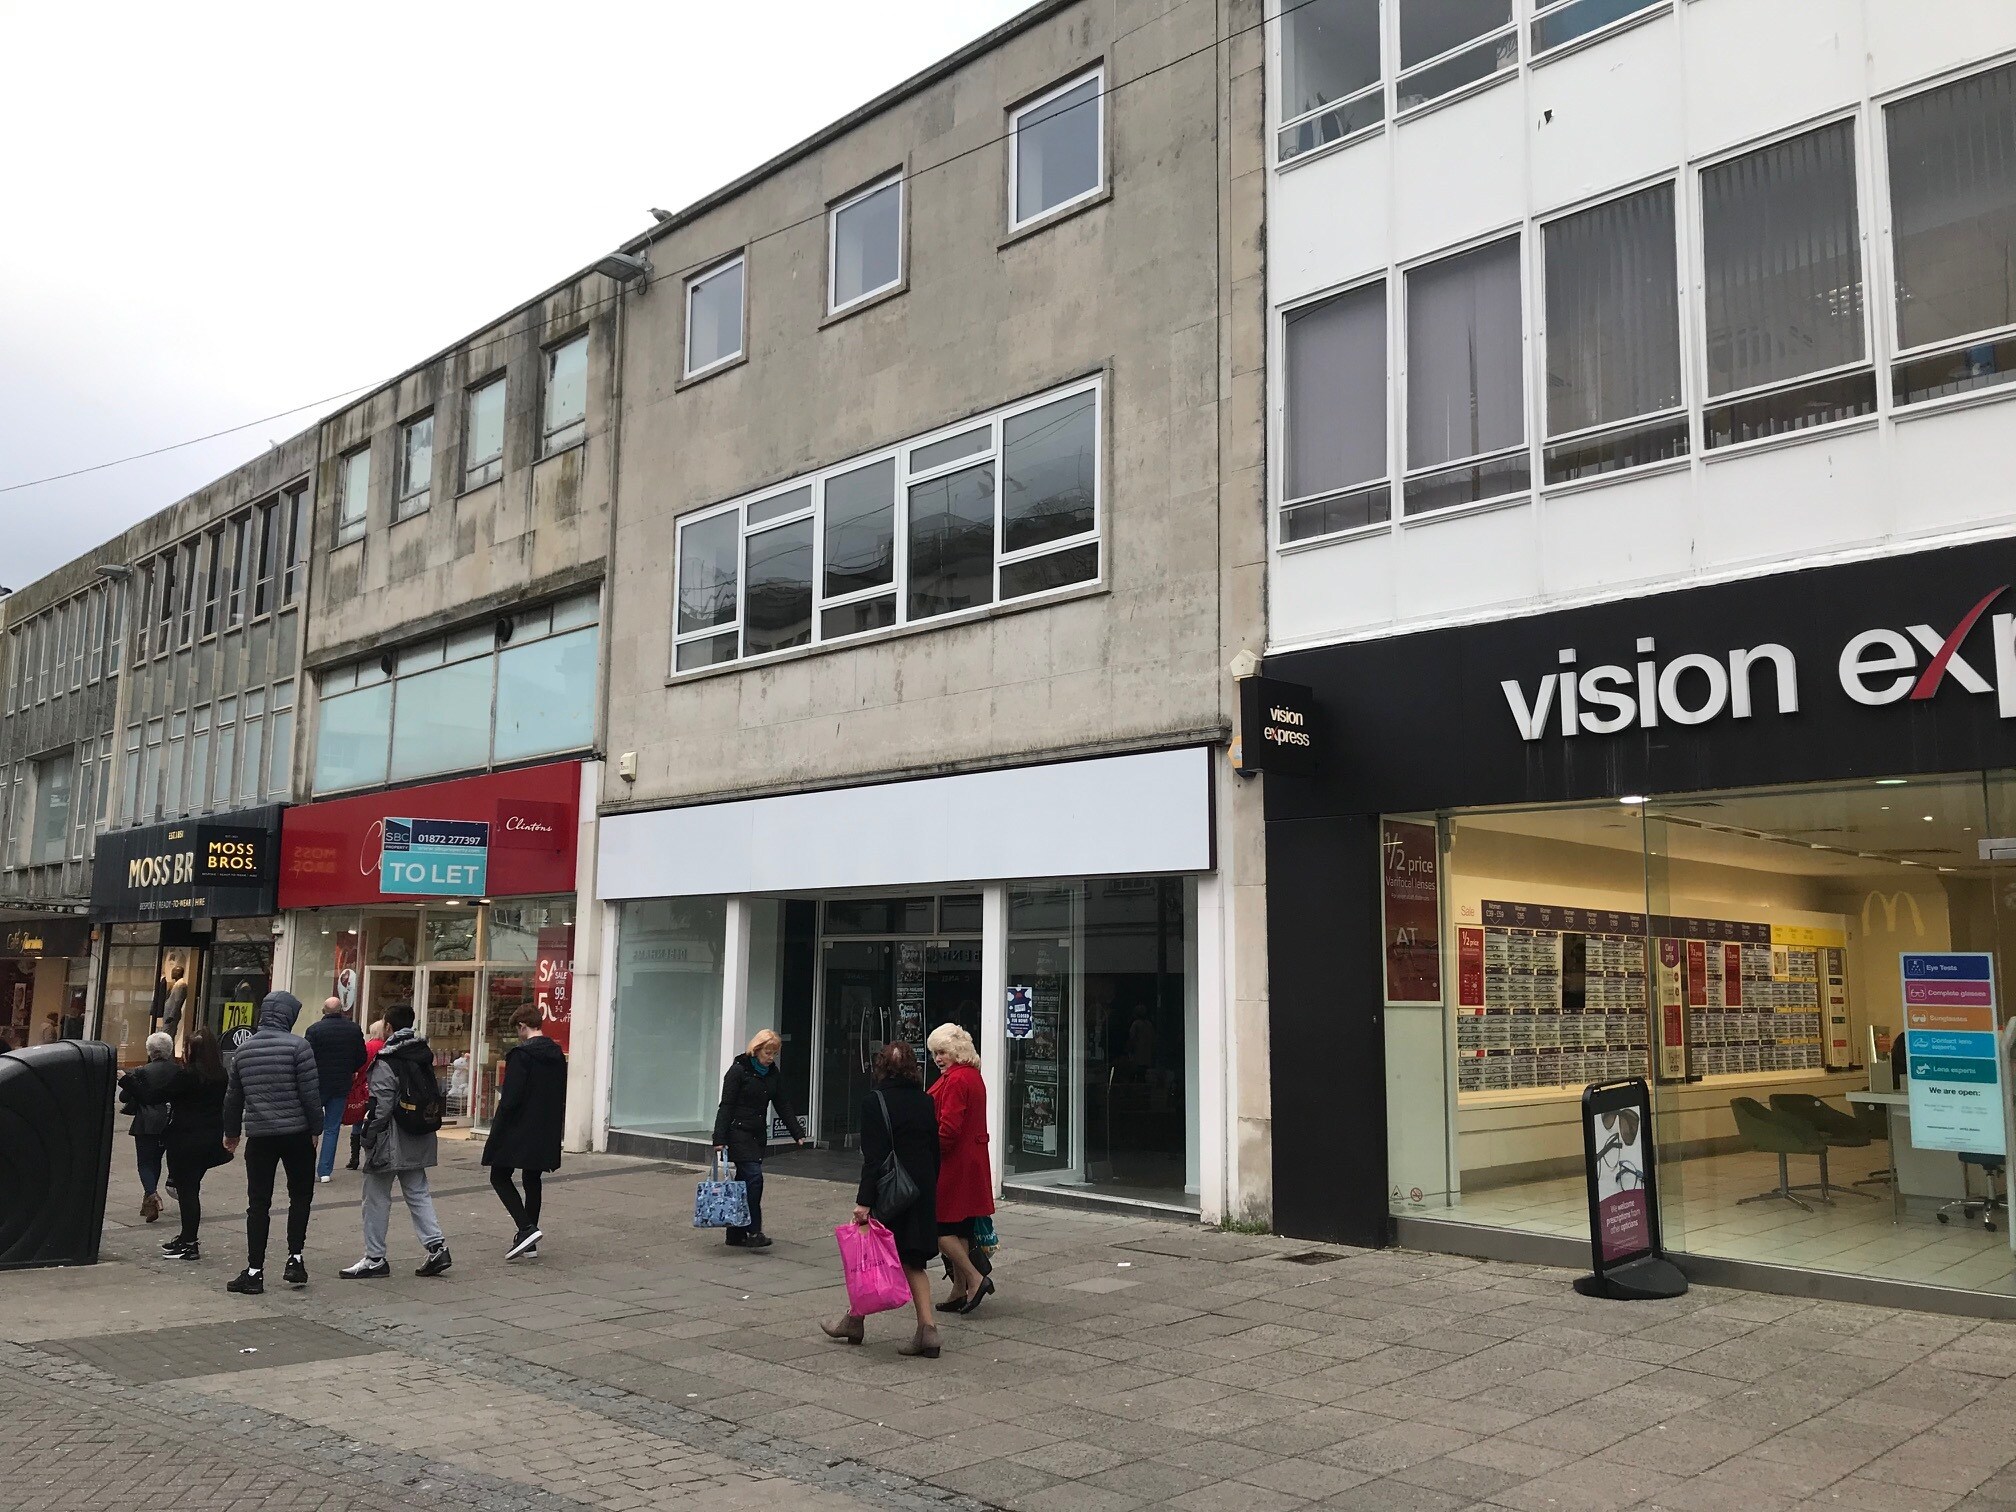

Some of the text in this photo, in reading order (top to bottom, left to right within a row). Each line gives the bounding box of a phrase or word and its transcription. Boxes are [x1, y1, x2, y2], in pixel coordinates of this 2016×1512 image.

[1500, 636, 1799, 740] vision
[1270, 705, 1303, 725] vision
[1264, 726, 1310, 746] express
[506, 816, 552, 831] Clintons
[386, 832, 409, 842] SBC
[418, 834, 481, 846] 01872 277397
[209, 842, 254, 855] MOSS
[208, 856, 257, 870] BROS.
[1409, 856, 1433, 876] price
[128, 854, 171, 889] MOSS
[390, 863, 479, 884] TO LET
[1460, 905, 1475, 917] Sale
[1926, 964, 1938, 972] Eye
[1928, 989, 1986, 998] Complete glasses
[228, 1005, 248, 1029] 70%
[1929, 1014, 1968, 1023] Sunglasses
[1958, 1089, 1981, 1097] open:
[1618, 1200, 1635, 1210] welcome
[1606, 1211, 1630, 1227] prescriptions
[1620, 1219, 1639, 1232] opticians
